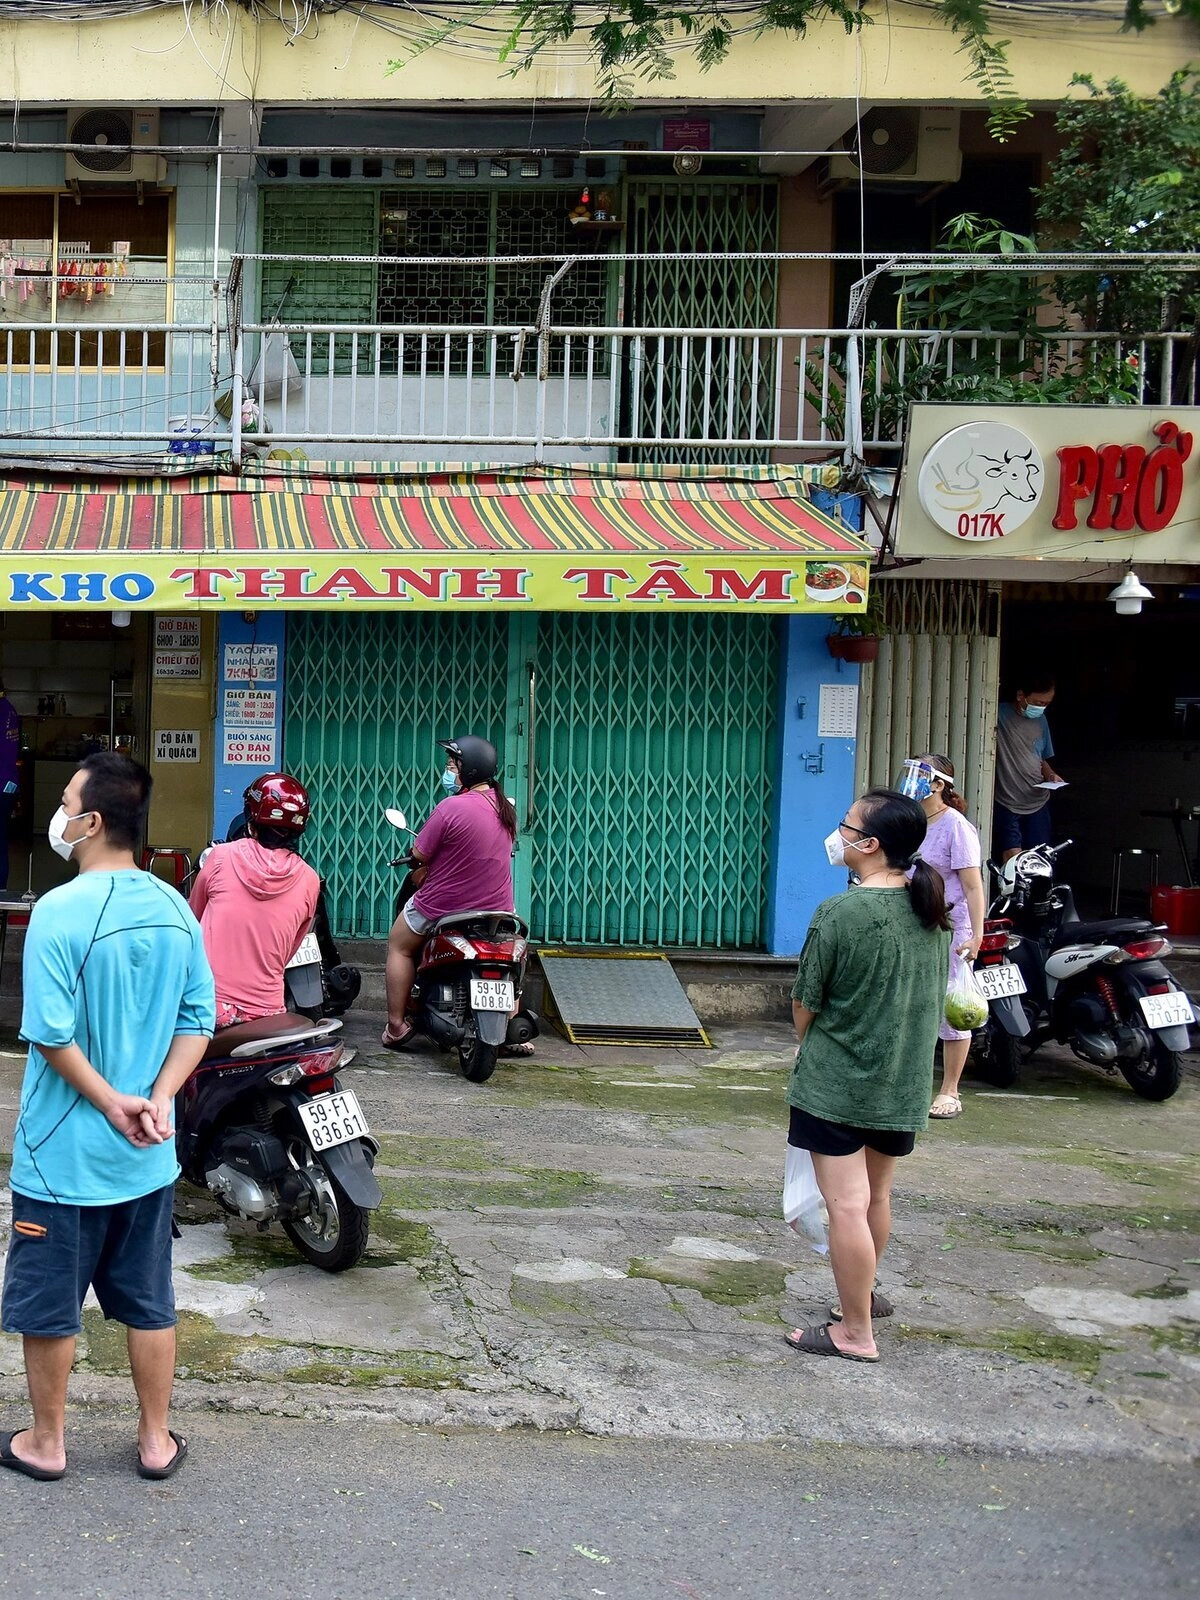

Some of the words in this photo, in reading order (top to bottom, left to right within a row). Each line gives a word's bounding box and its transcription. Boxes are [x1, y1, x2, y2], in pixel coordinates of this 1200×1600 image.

[1052, 419, 1193, 533] PHỞ
[957, 513, 1005, 537] 017K
[9, 572, 156, 602] KHO
[168, 566, 530, 602] THANH
[561, 559, 798, 602] TÂM
[176, 619, 198, 630] BÁN:
[156, 634, 173, 646] 6H00
[179, 634, 199, 646] 12H30
[227, 656, 250, 666] NHÀ
[248, 690, 271, 700] BÁN
[161, 732, 172, 744] CÓ
[175, 732, 193, 744] BÁN
[250, 732, 272, 741] SÁNG
[157, 745, 166, 758] XÍ
[169, 746, 197, 759] QUÁCH
[228, 742, 245, 751] CÓ
[247, 742, 270, 752] BÁN
[227, 752, 243, 762] BÒ
[246, 754, 271, 762] KHO
[982, 967, 1014, 984] 60-F2
[477, 981, 507, 996] 59-U2
[982, 979, 1020, 998] 931.67
[474, 995, 511, 1009] 408.84
[218, 1064, 256, 1078] VISION
[308, 1095, 350, 1124] 59-F1
[312, 1114, 363, 1146] 836.61
